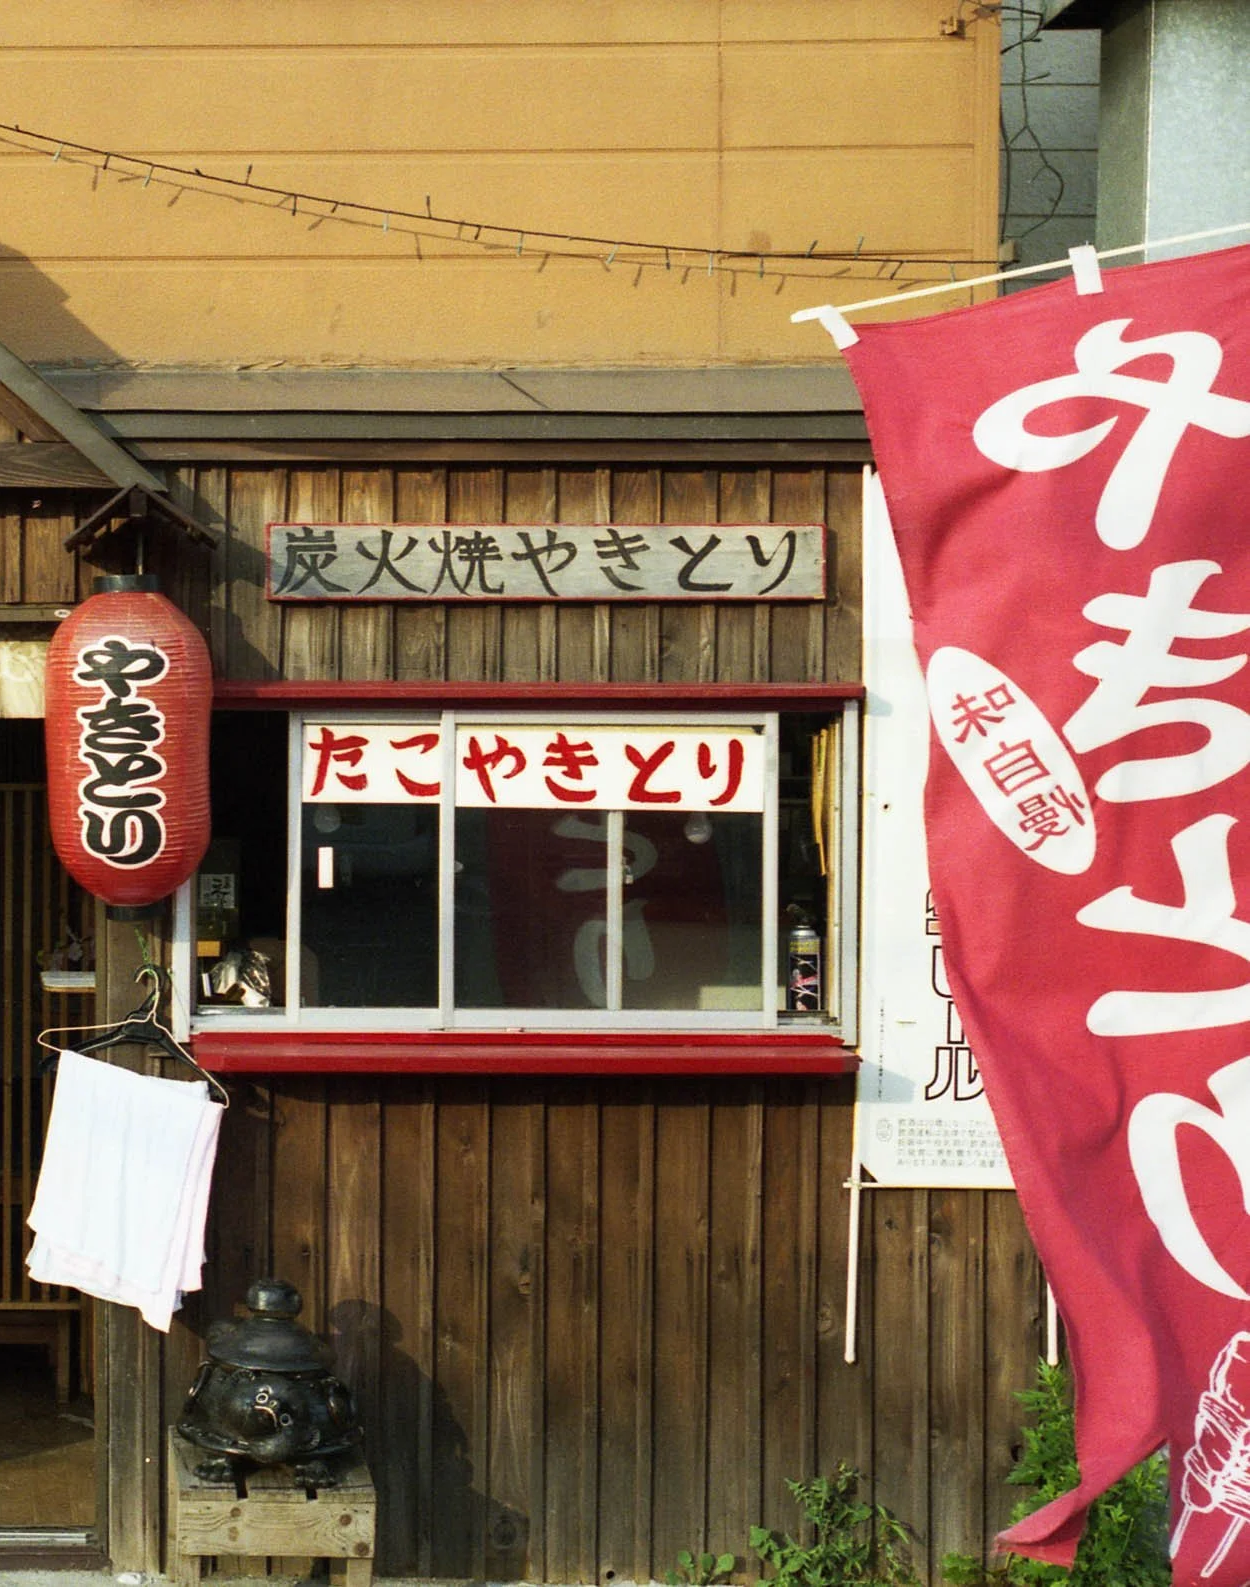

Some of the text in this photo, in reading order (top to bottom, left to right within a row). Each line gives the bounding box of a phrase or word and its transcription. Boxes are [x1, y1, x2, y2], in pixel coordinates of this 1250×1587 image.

[274, 526, 798, 597] 炭火焼やきとり
[72, 635, 170, 869] やきとり
